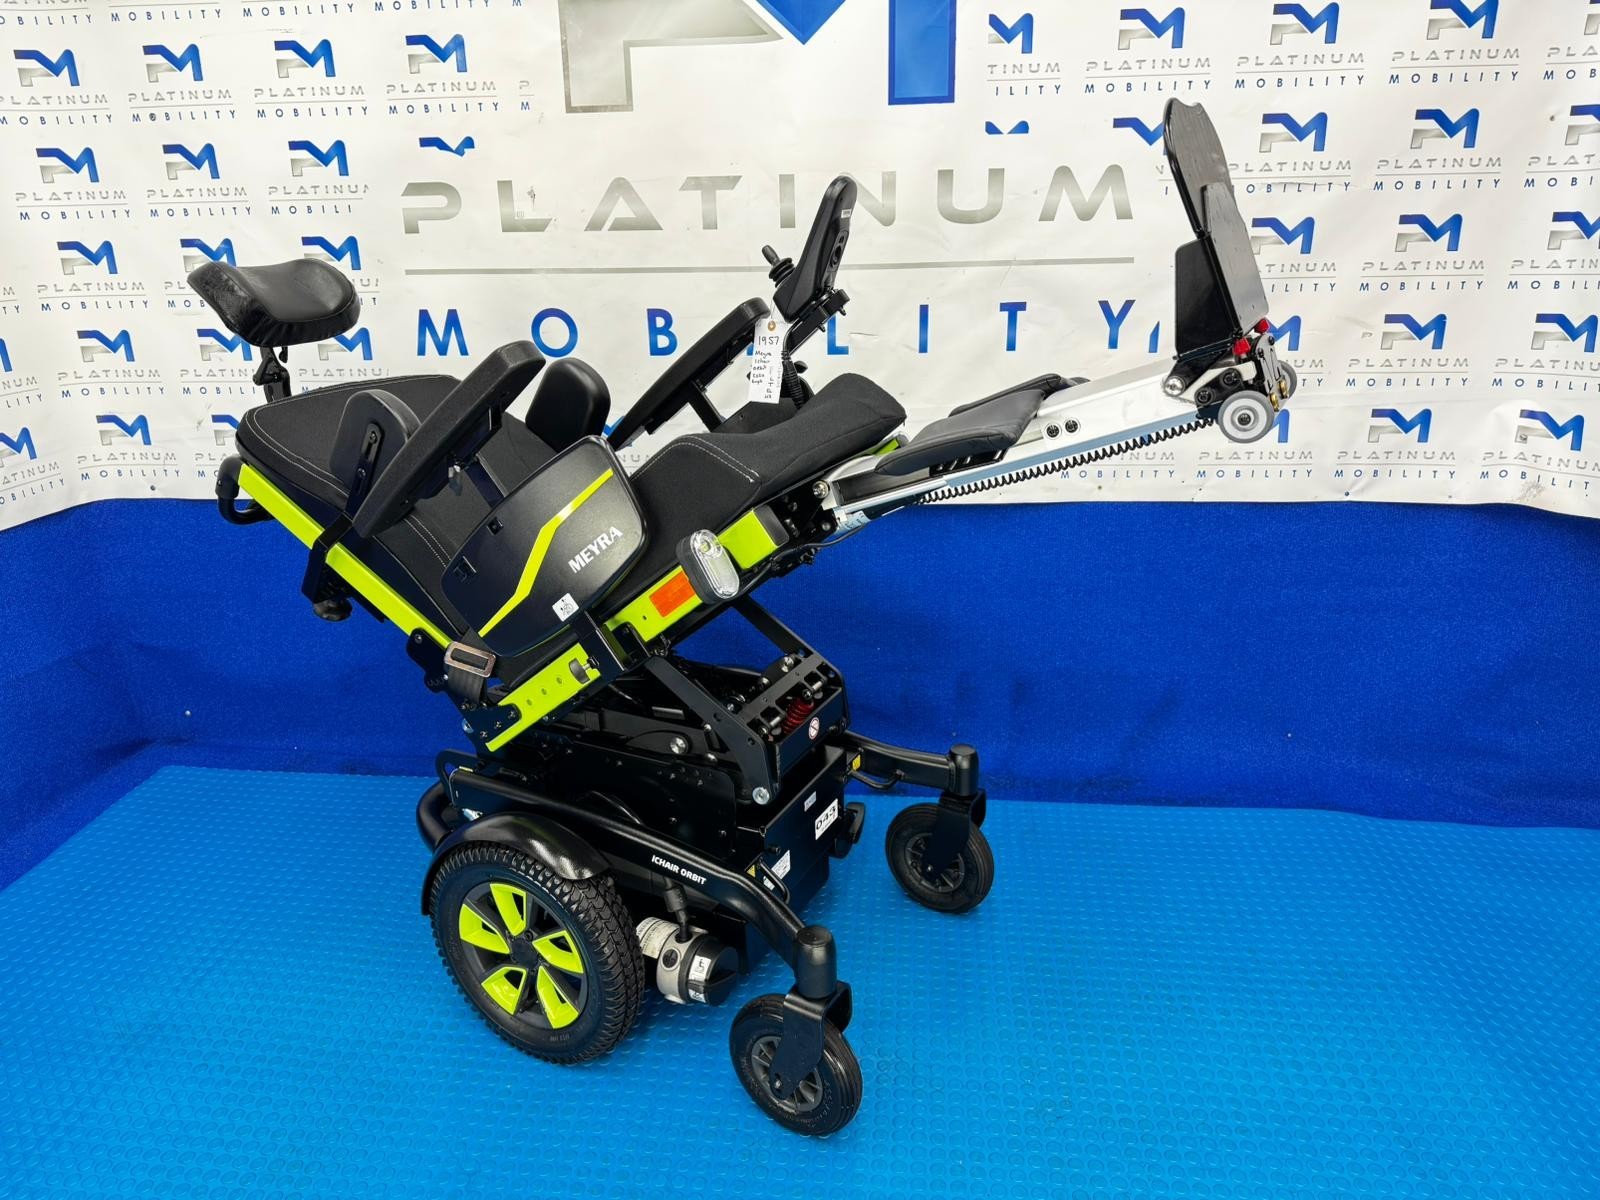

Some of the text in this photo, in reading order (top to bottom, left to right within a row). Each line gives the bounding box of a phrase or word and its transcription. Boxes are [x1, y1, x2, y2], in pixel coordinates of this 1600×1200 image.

[111, 9, 221, 21] MOBILITY
[243, 3, 353, 17] MOBILITY
[1237, 51, 1364, 66] PLATINUM
[1391, 47, 1520, 62] PLATINUM
[1085, 57, 1211, 71] PLATINUM
[1234, 75, 1364, 89] MOBILITY
[1389, 71, 1519, 84] MOBILITY
[254, 85, 365, 97] PLATINUM
[386, 81, 497, 94] PLATINUM
[1085, 79, 1211, 94] MOBILITY
[128, 89, 232, 102] PLATINUM
[257, 106, 369, 118] MOBILITY
[389, 102, 499, 115] MOBILITY
[0, 114, 112, 125] MOBILITY
[132, 110, 235, 122] MOBILITY
[1377, 156, 1502, 170] PLATINUM
[1232, 181, 1350, 193] OBILITY
[1374, 178, 1500, 191] MOBILITY
[15, 189, 127, 201] PLATINUM
[147, 186, 248, 198] PLATINUM
[400, 164, 1134, 234] PLATINUM
[20, 209, 130, 220] MOBILITY
[150, 205, 251, 217] MOBILITY
[1361, 258, 1485, 271] PLATINUM
[37, 282, 145, 293] PLATINUM
[1359, 279, 1484, 292] MOBILITY
[41, 300, 148, 311] MOBILITY
[417, 299, 1136, 357] MOBLITY
[758, 335, 780, 346] 1957
[1348, 357, 1469, 368] PLATINUM
[58, 368, 161, 381] PLATINUM
[1346, 377, 1468, 388] MOBILITY
[62, 386, 165, 398] MOBILITY
[77, 452, 177, 464] PLATINUM
[1199, 451, 1312, 461] PLATINUM
[1337, 450, 1456, 461] PLATINUM
[81, 469, 181, 480] MOBILITY
[1060, 469, 1175, 479] MOBILITY
[1196, 469, 1312, 479] MOBILITY
[1334, 469, 1456, 479] MOBILITY
[567, 526, 623, 573] MEYRA
[651, 854, 707, 885] ICHAIR ORBIT
